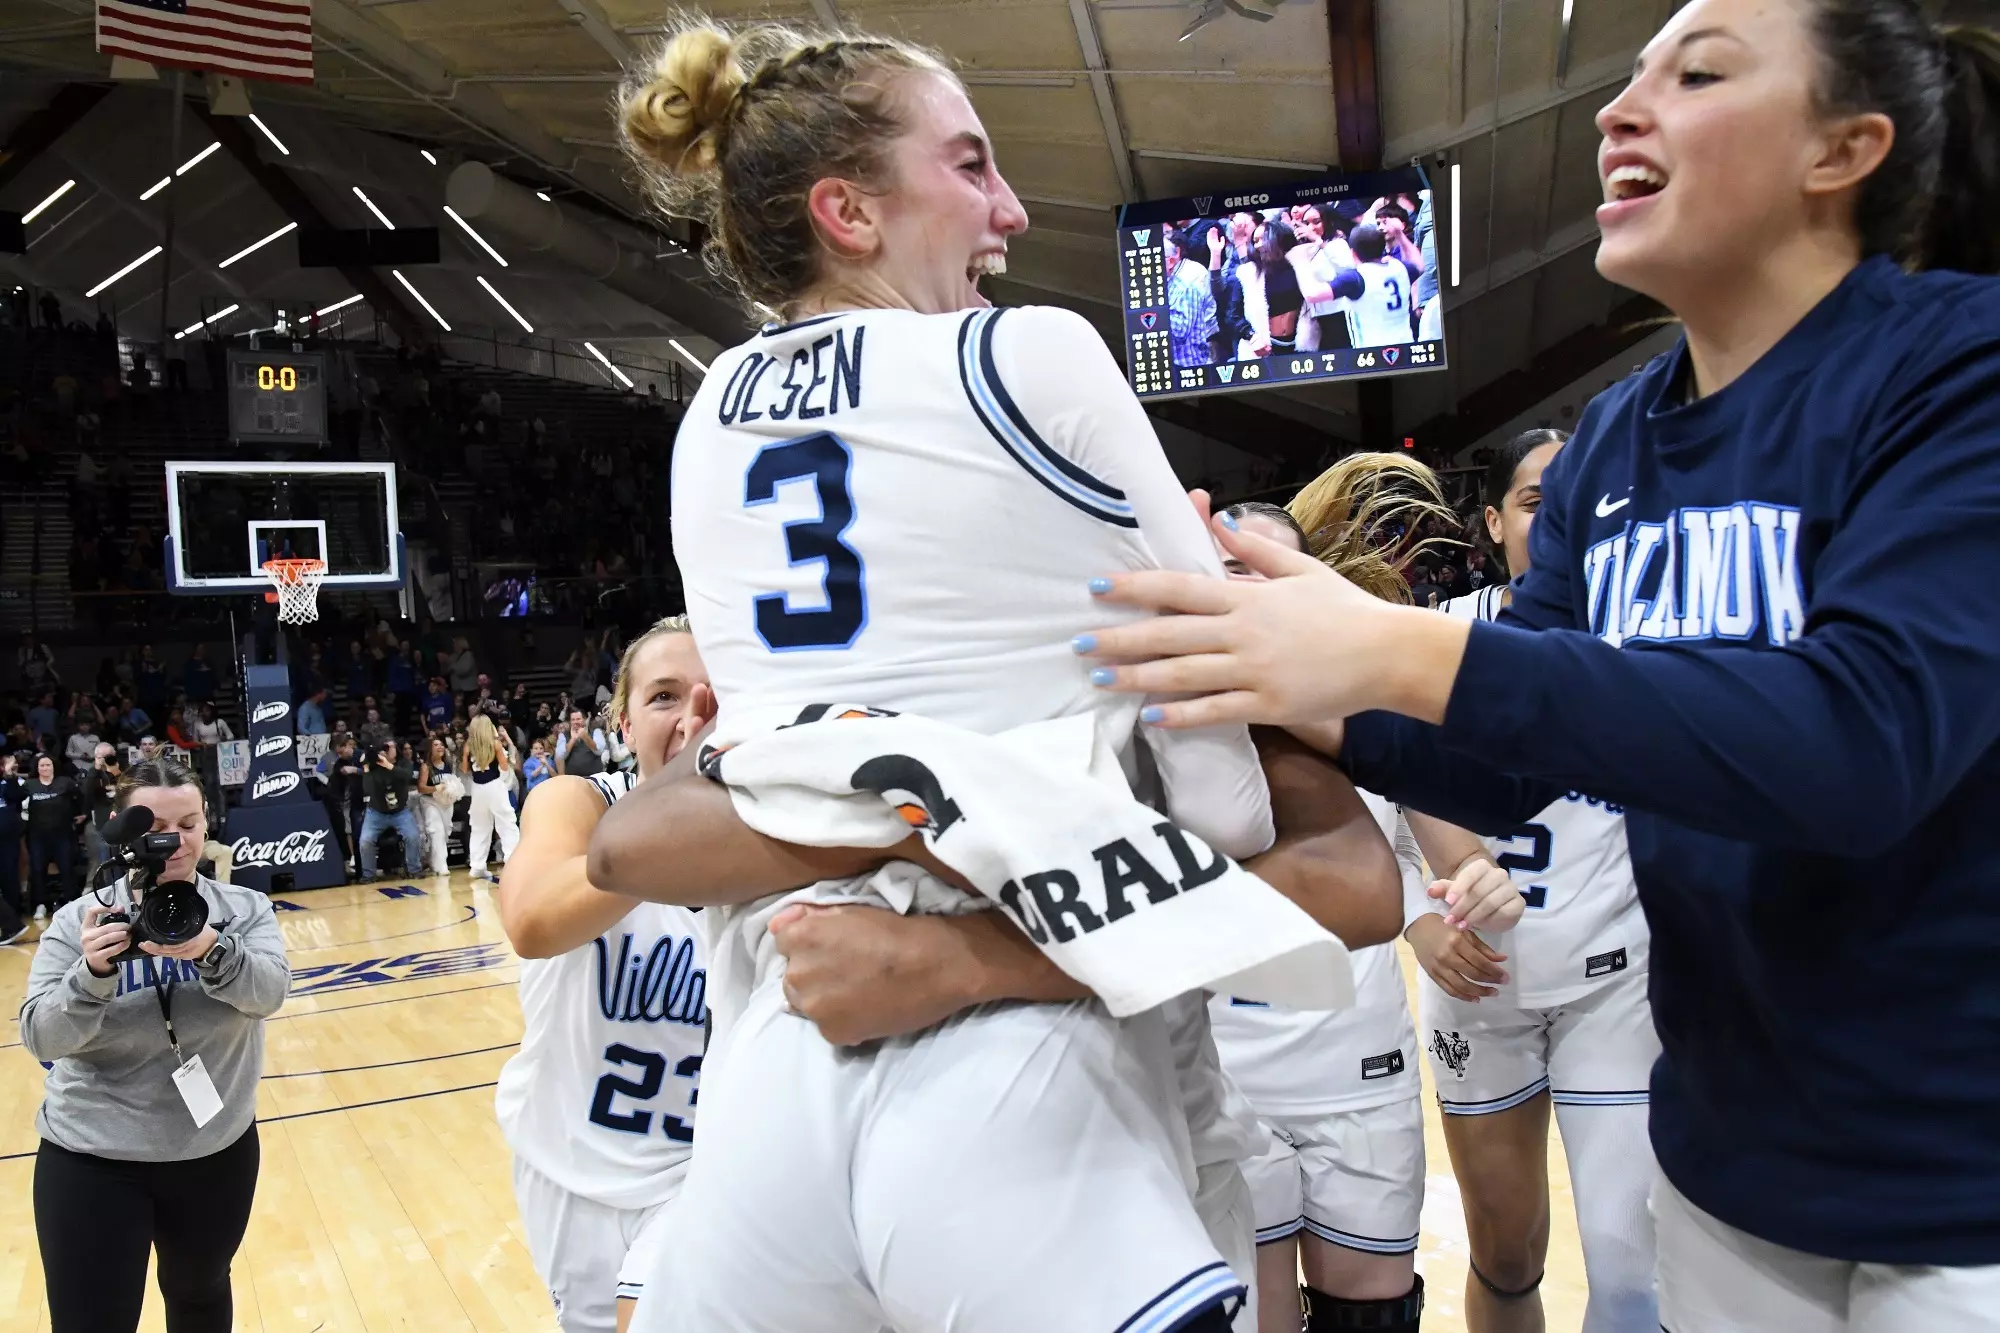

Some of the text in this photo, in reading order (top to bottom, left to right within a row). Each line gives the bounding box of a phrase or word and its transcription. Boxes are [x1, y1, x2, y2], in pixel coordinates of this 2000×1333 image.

[1296, 184, 1349, 198] VIDEO BOARD
[1224, 193, 1270, 208] GRECO
[1384, 278, 1402, 311] 3
[1135, 362, 1145, 371] 12
[1241, 364, 1260, 379] 68
[1291, 359, 1314, 374] 0.0
[1357, 352, 1376, 368] 66
[719, 325, 865, 425] OLSEN
[1150, 371, 1160, 381] 11
[743, 430, 869, 653] 3
[1584, 501, 1804, 650] VILANOV
[252, 705, 288, 724] LIBMAN
[219, 743, 240, 755] WE
[255, 739, 290, 757] LIBMAN
[252, 776, 295, 800] LIBMAN
[1392, 1057, 1400, 1068] M
